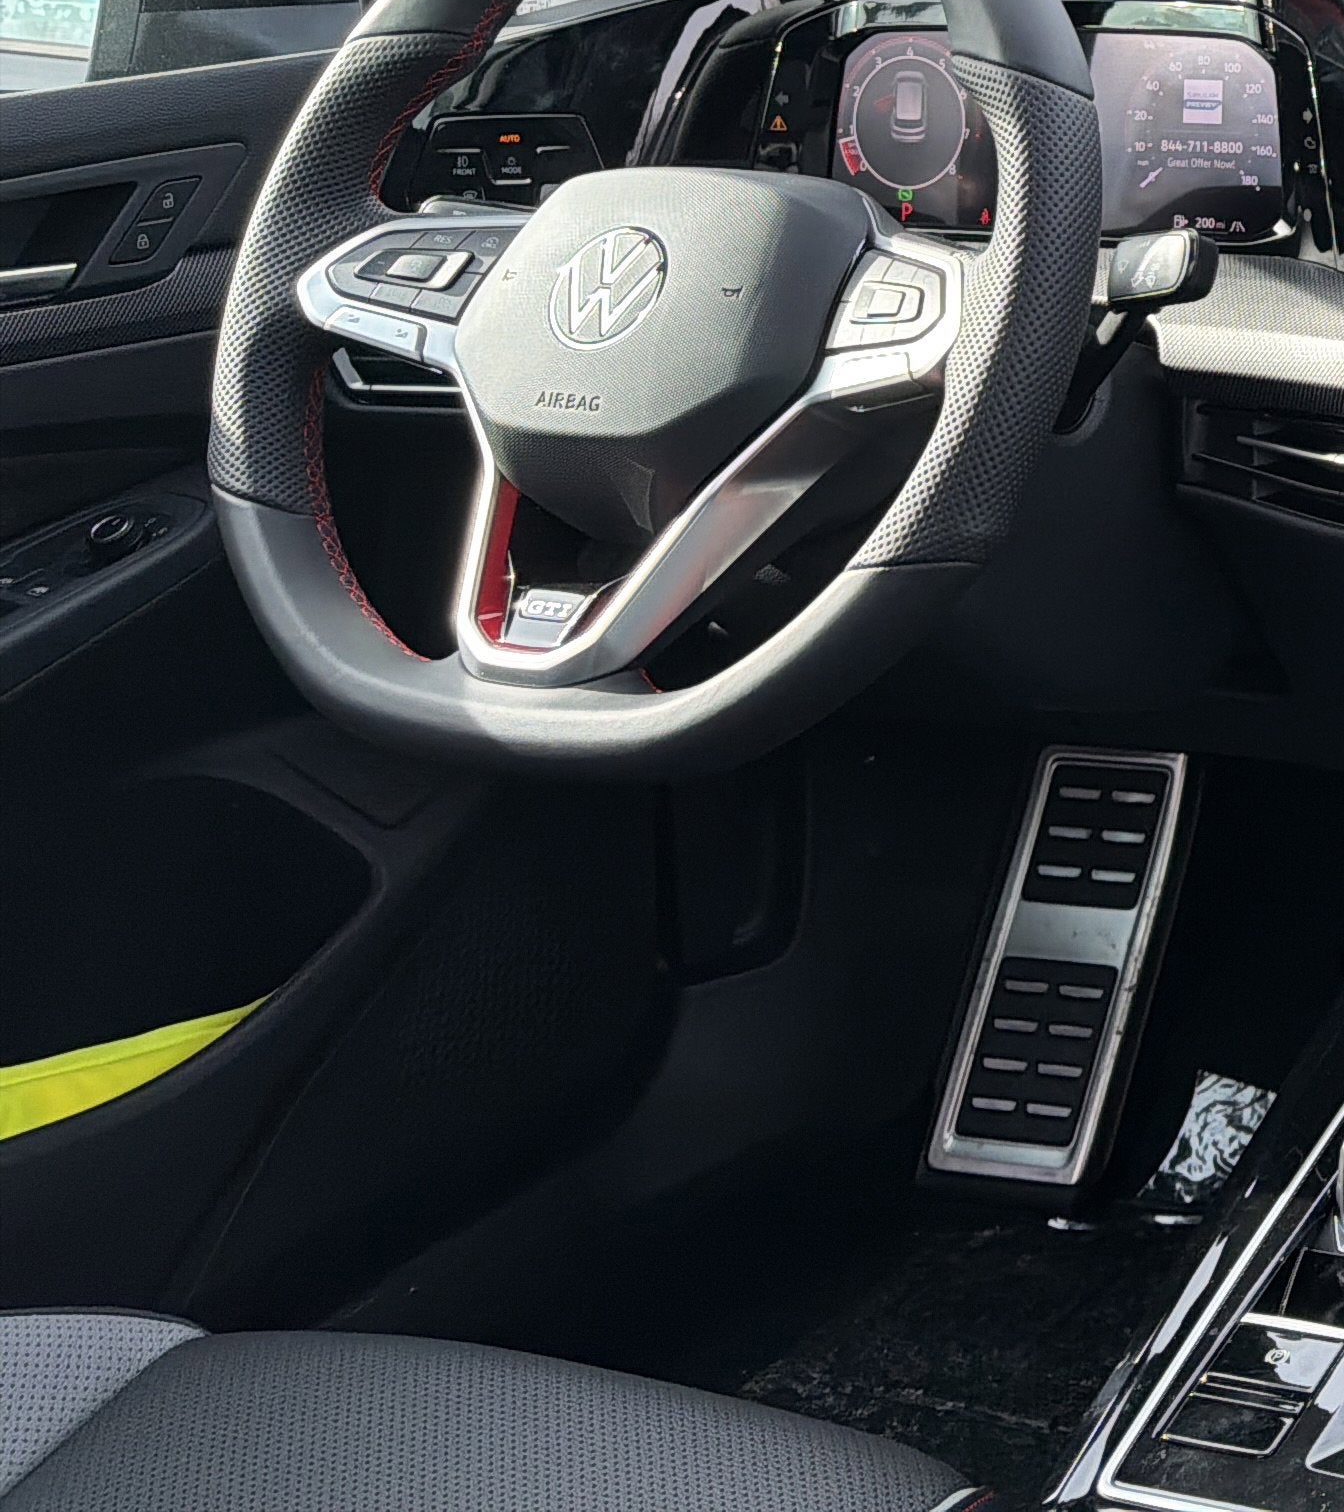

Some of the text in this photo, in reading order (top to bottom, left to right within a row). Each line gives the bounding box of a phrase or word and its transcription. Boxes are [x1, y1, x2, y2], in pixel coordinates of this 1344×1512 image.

[1198, 55, 1211, 66] 80
[1169, 61, 1183, 72] 60
[1224, 62, 1241, 74] 100
[1245, 83, 1262, 95] 120
[1134, 110, 1148, 121] 20
[1256, 114, 1274, 125] 140
[499, 134, 521, 143] AUTO
[1134, 141, 1146, 152] 10
[1160, 140, 1244, 154] 844-711-8800
[1255, 145, 1273, 157] 160
[1167, 157, 1237, 171] Great Offer Now!
[452, 168, 477, 176] FRONT
[501, 167, 522, 175] MODE
[1241, 175, 1259, 186] 180
[901, 203, 914, 222] P
[1194, 217, 1216, 229] 200
[433, 234, 453, 245] RES
[534, 391, 601, 412] AIRBAG
[527, 600, 573, 619] GTI
